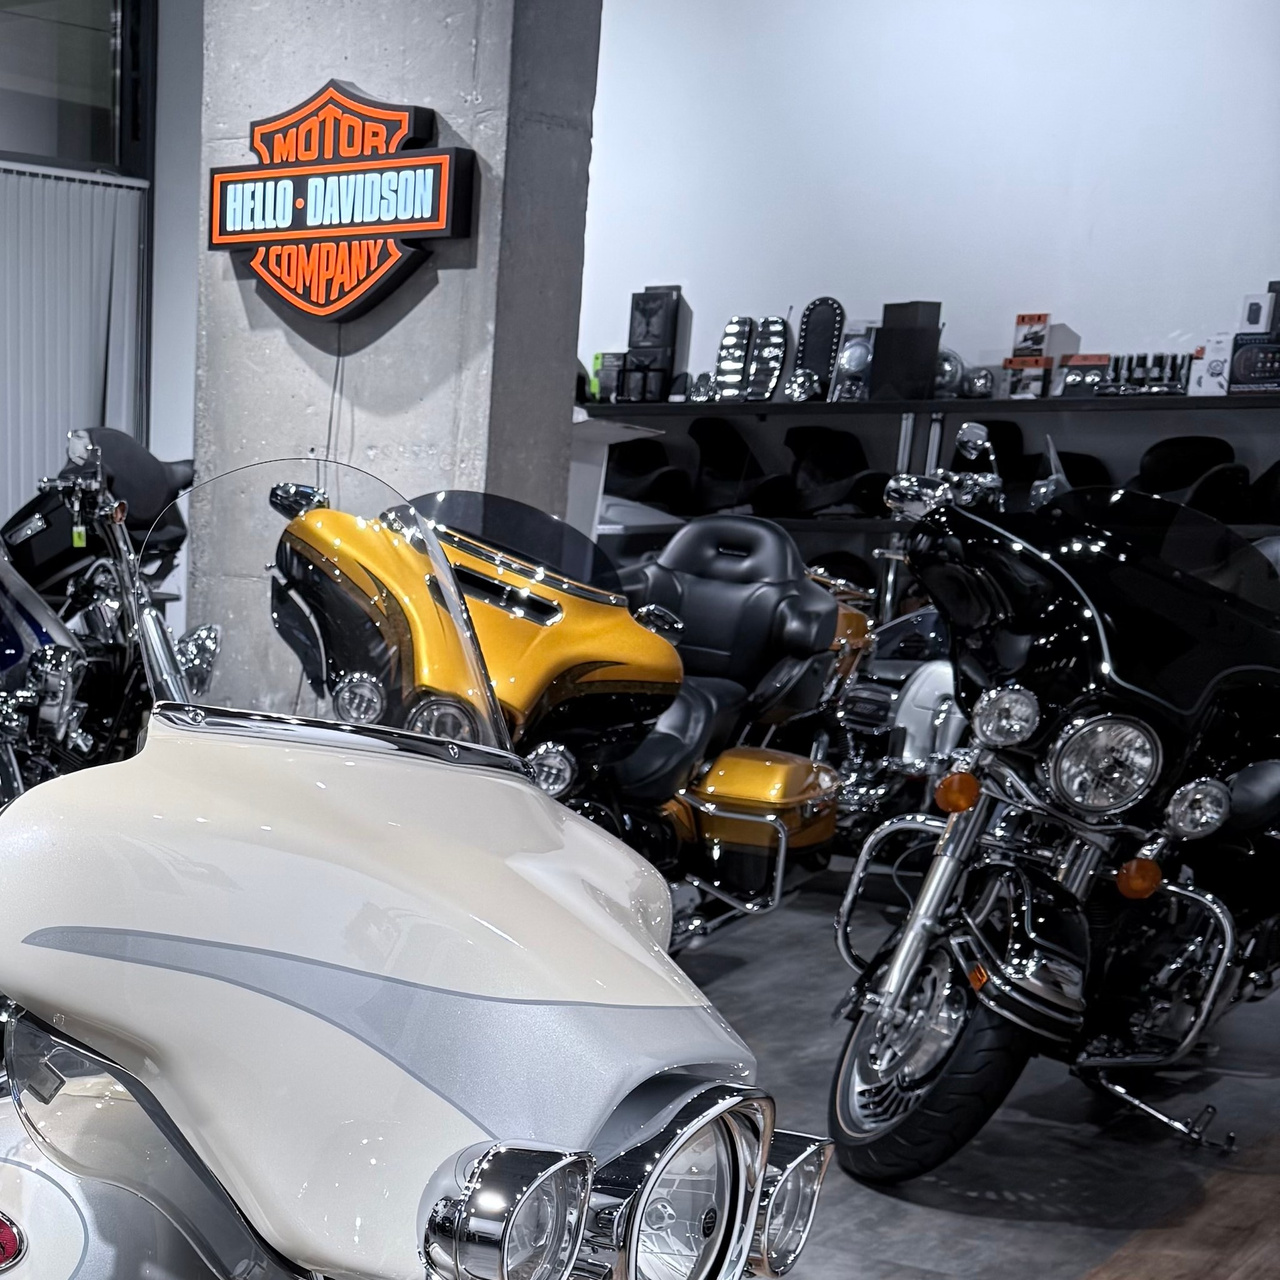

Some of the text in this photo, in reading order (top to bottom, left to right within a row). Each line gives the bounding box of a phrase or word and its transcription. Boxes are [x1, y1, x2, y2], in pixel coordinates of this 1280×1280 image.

[273, 103, 387, 164] MOTOR
[226, 168, 434, 232] HELLO DAVIDSON
[269, 239, 383, 304] COMPANY
